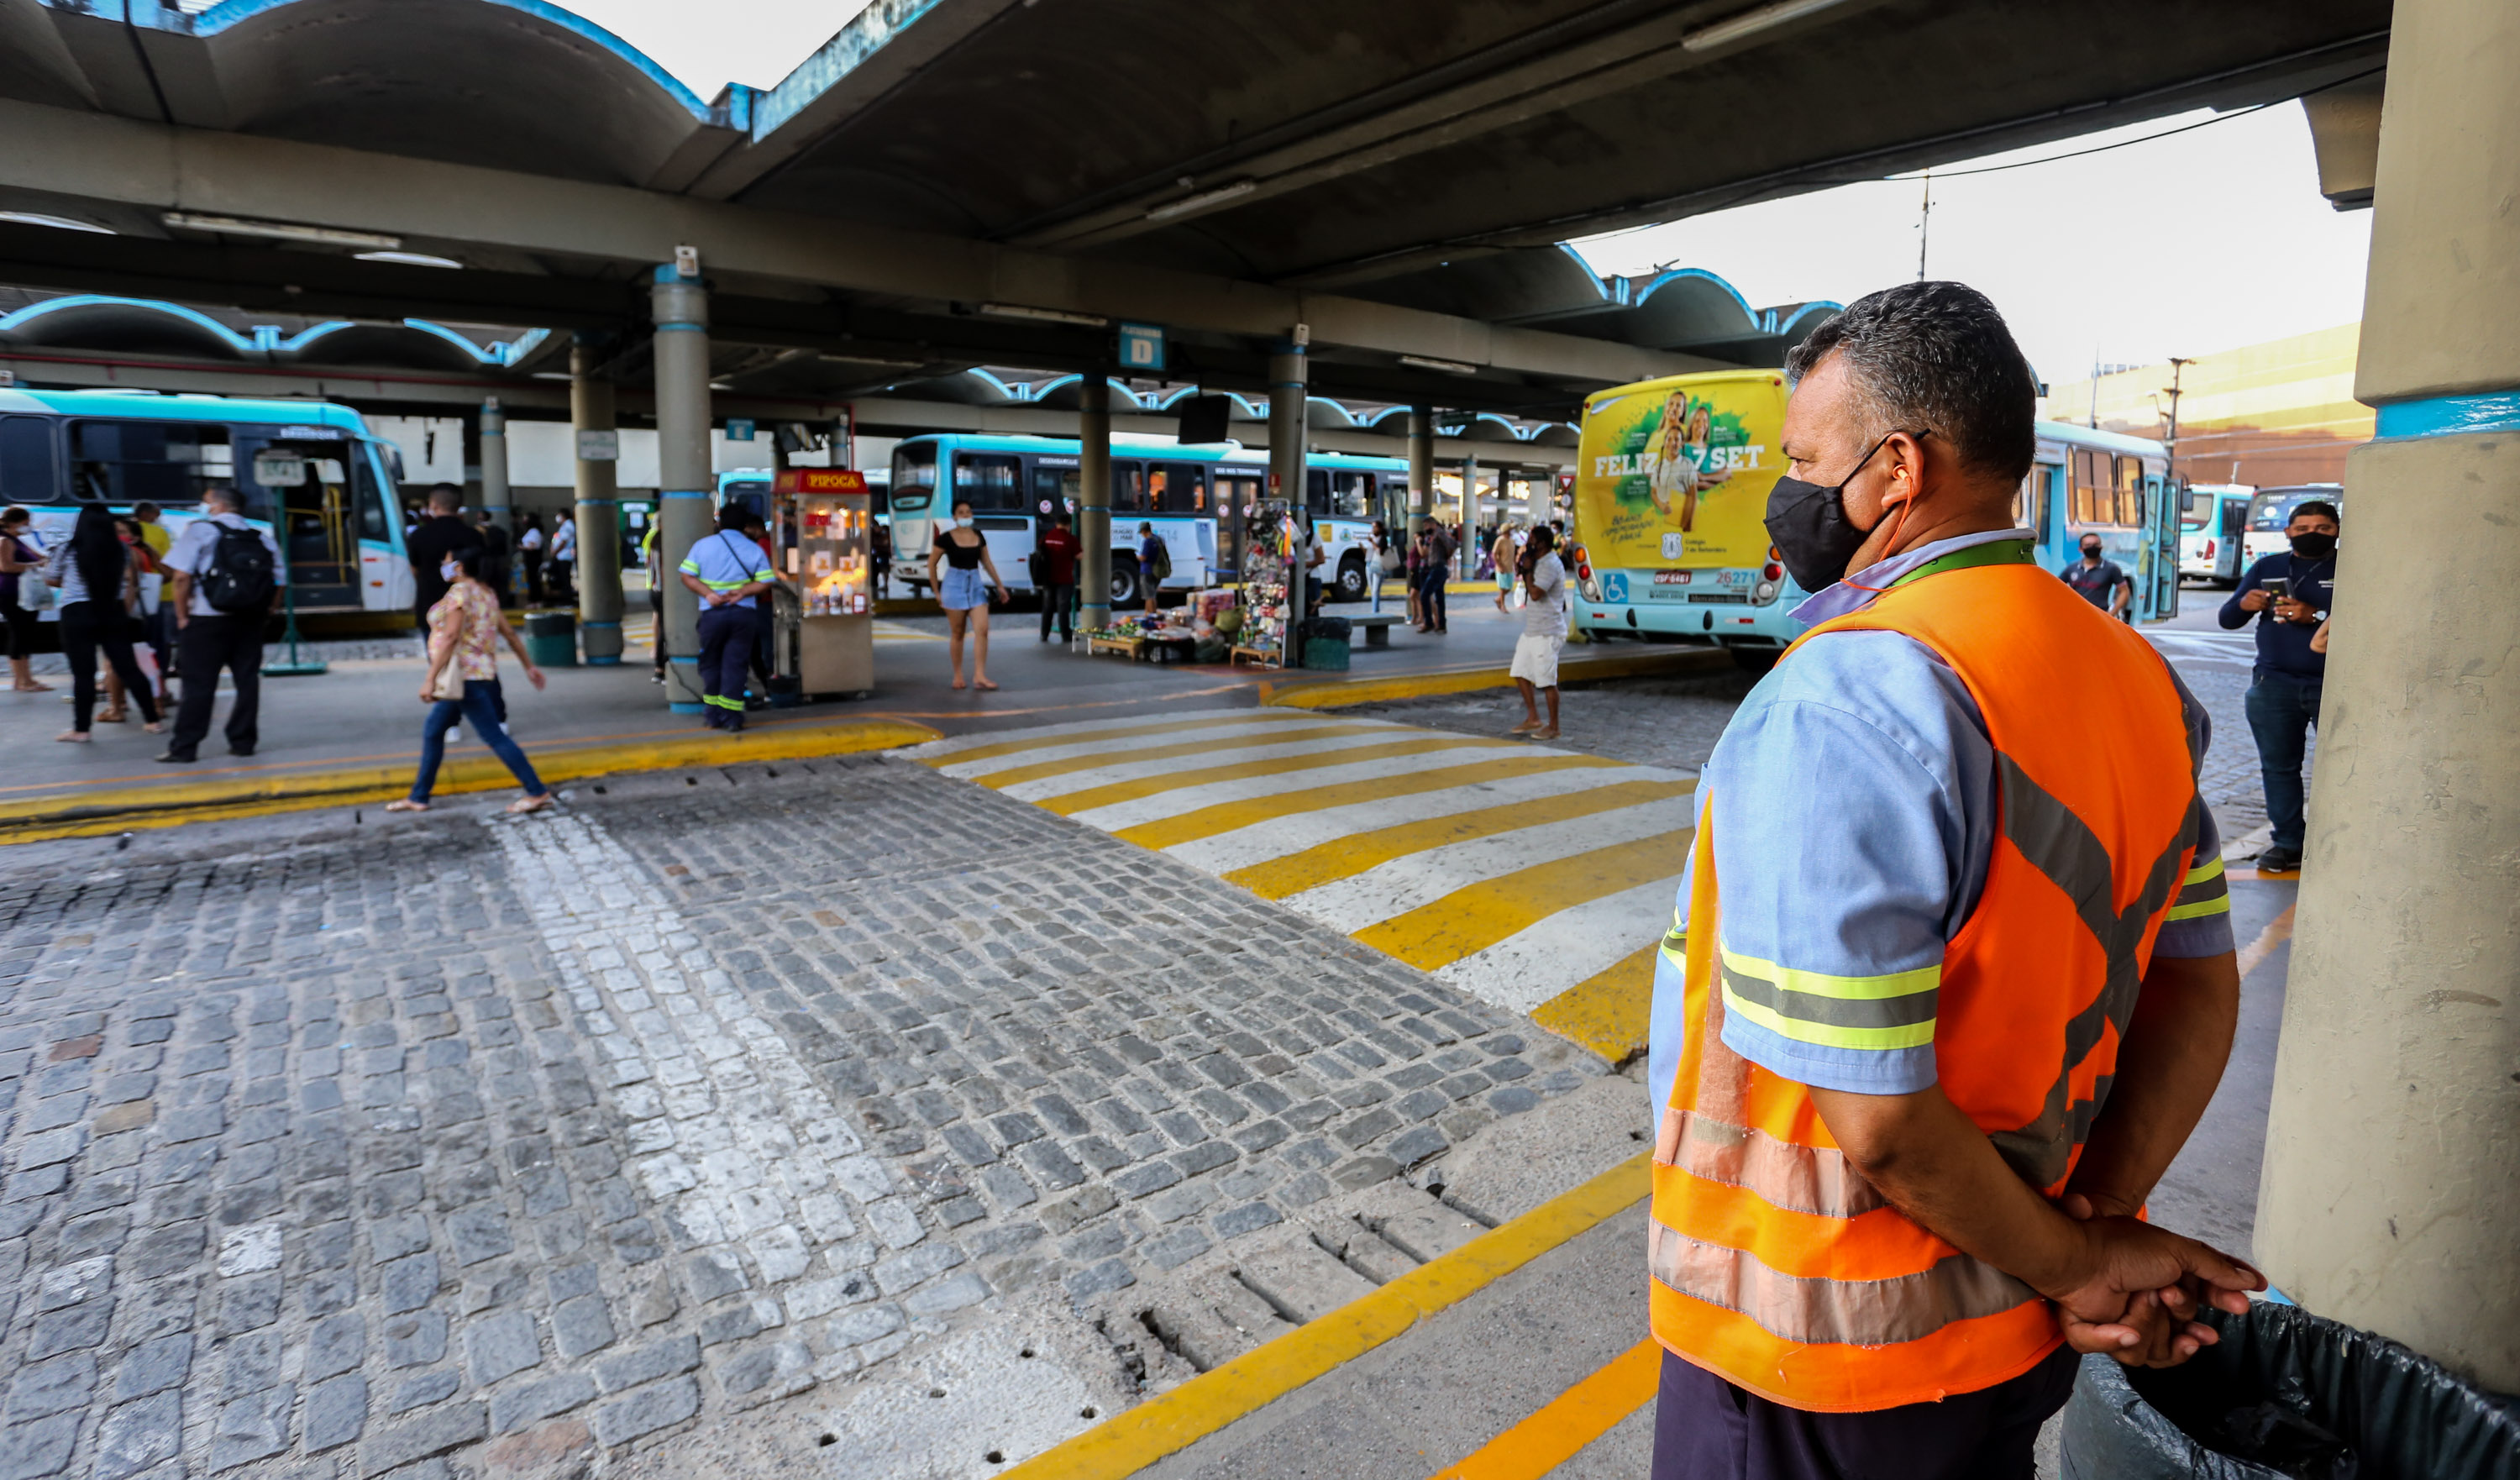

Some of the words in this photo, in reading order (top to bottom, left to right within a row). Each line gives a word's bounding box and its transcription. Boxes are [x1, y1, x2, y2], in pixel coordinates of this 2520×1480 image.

[1131, 339, 1152, 364] D
[1594, 452, 1659, 477] FELIZ
[1693, 449, 1708, 470] 7
[1709, 445, 1765, 470] SET
[809, 474, 858, 488] PIPOCA
[1716, 571, 1756, 585] 26271
